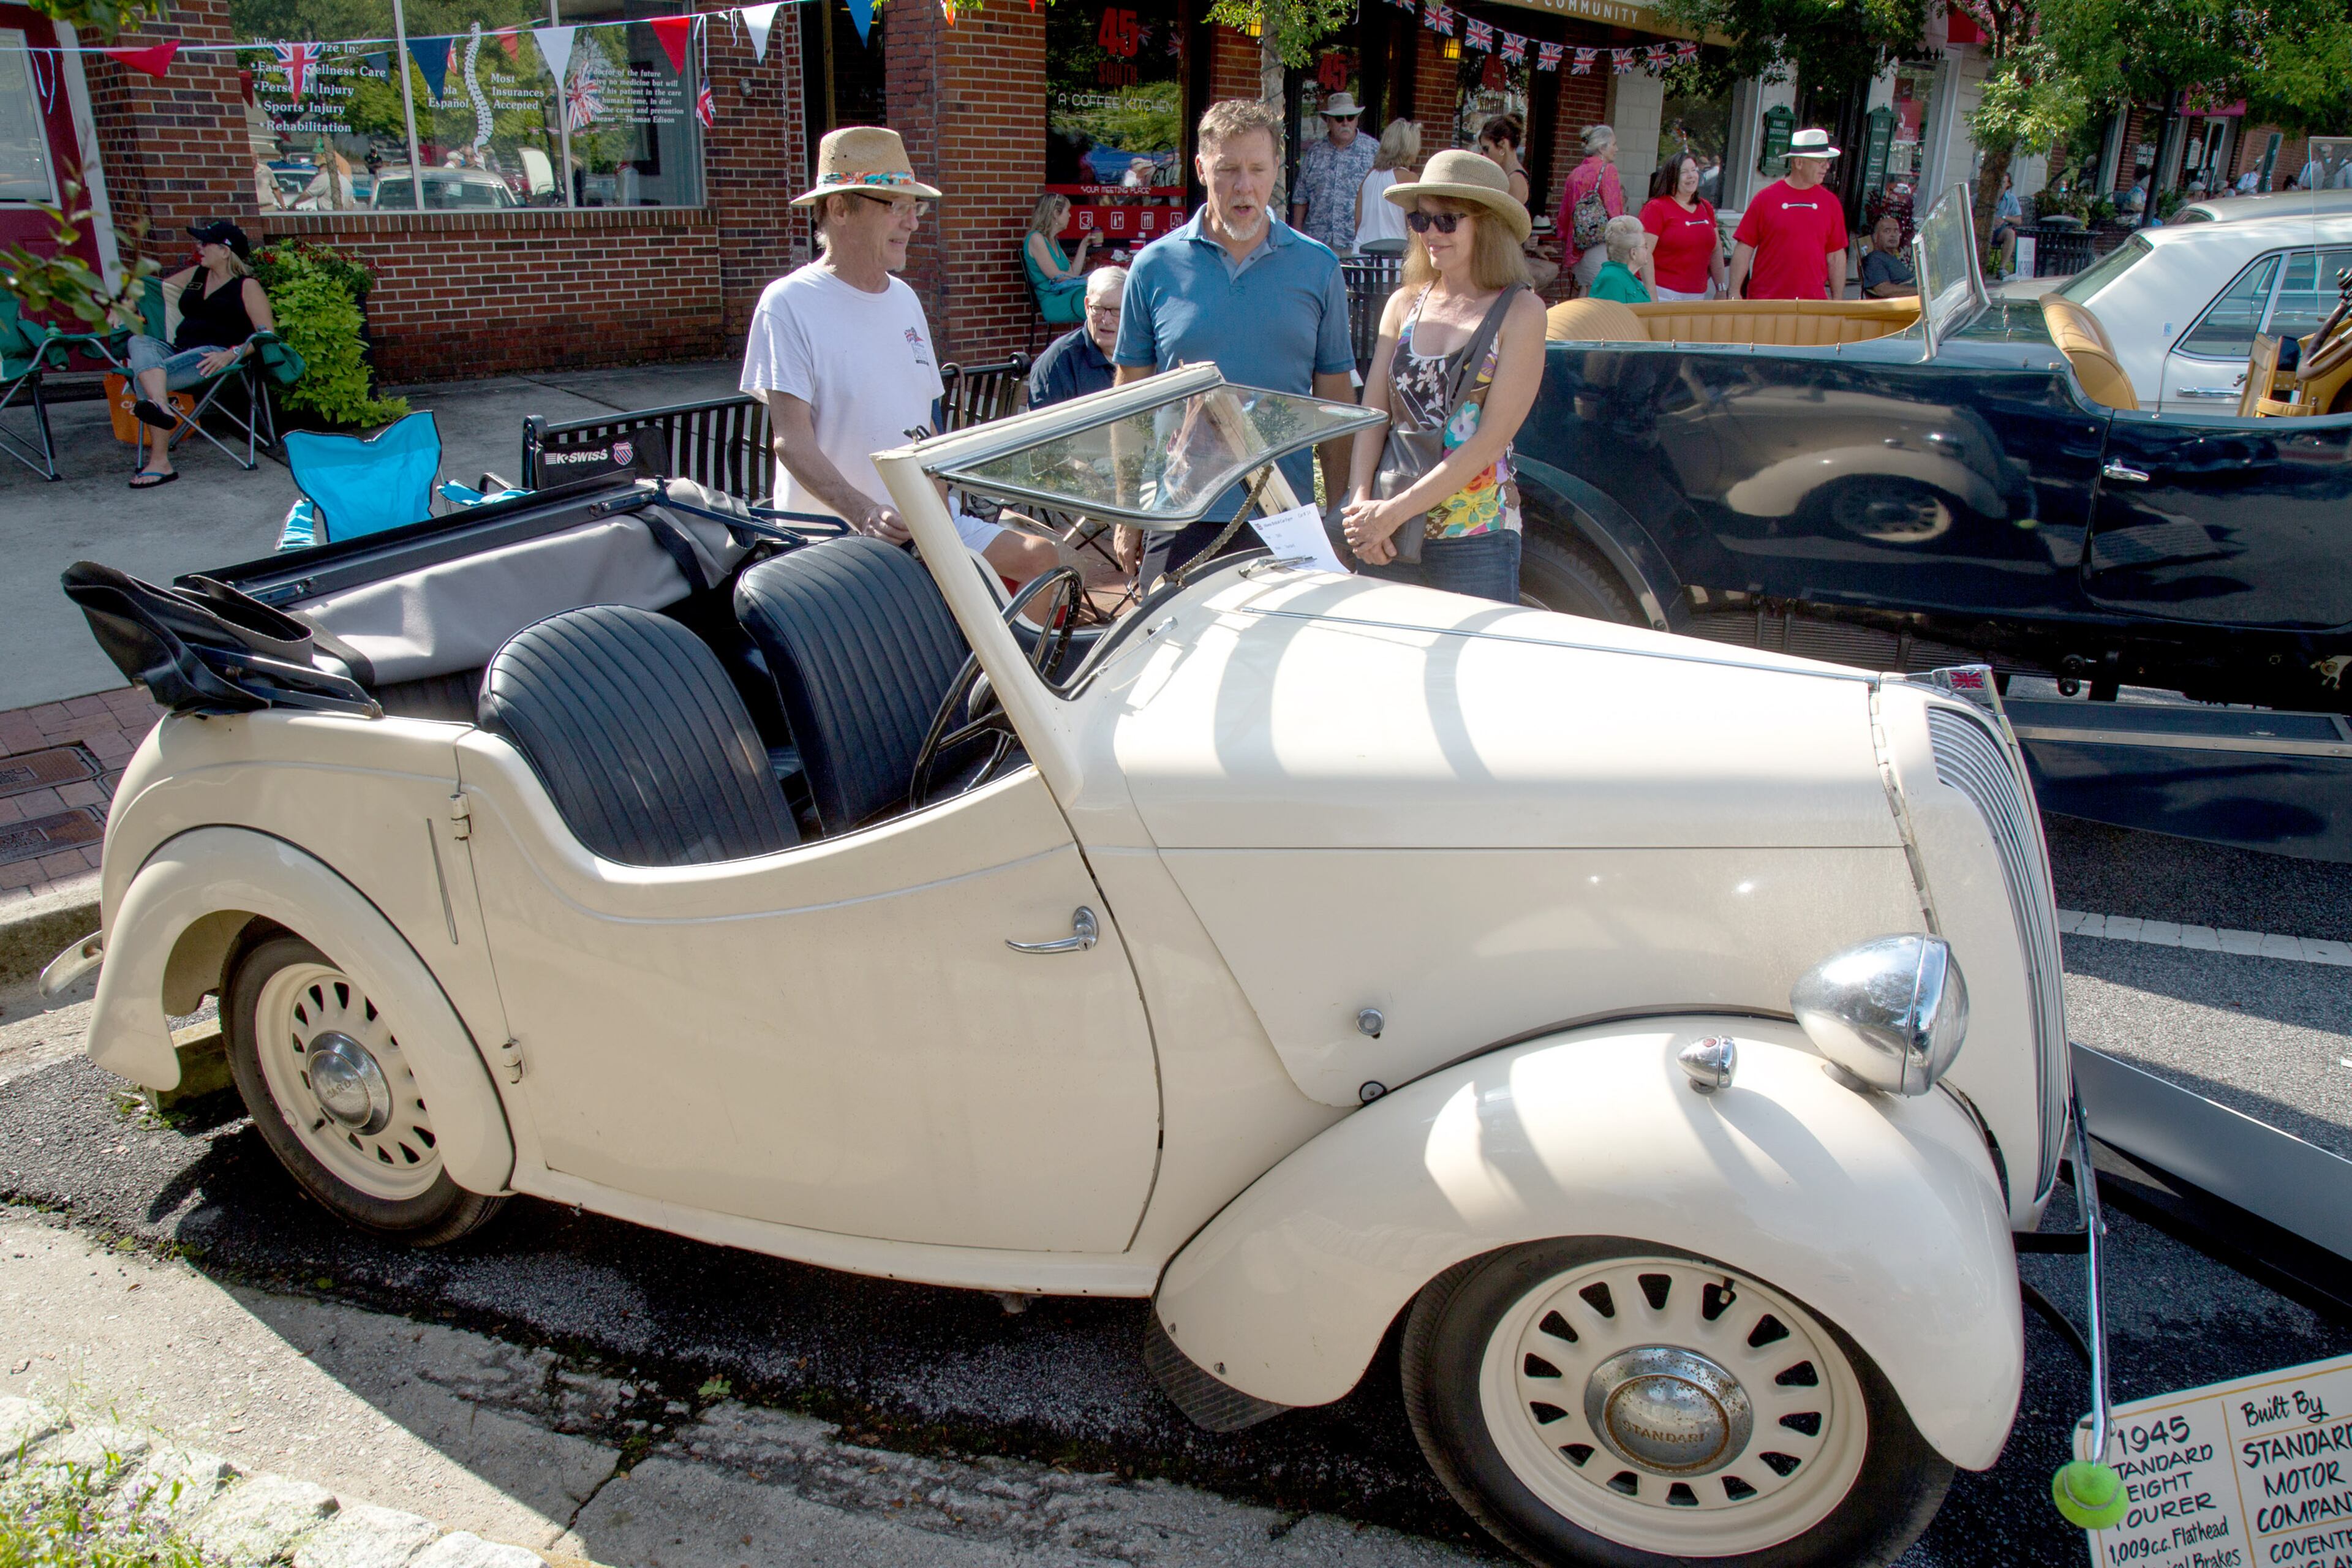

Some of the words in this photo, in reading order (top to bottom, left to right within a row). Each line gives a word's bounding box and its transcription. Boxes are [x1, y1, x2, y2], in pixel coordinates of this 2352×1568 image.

[1098, 7, 1137, 57] 45
[344, 43, 360, 53] In:
[360, 66, 386, 78] Care
[491, 73, 515, 83] Most
[641, 69, 662, 78] future
[1098, 62, 1137, 86] SOUTH
[1319, 53, 1347, 92] 45
[261, 81, 314, 93] Persoal
[318, 83, 354, 97] Injury
[492, 86, 545, 97] Insurances
[264, 100, 304, 114] Sports
[309, 102, 345, 115] Injury
[494, 100, 538, 111] Accepted
[1058, 93, 1066, 105] A
[1072, 94, 1120, 109] COFFEE
[1125, 99, 1174, 112] KITCHEN
[266, 120, 351, 132] Rehabilitation
[2240, 1395, 2290, 1428] Built
[2291, 1390, 2330, 1423] By
[2117, 1415, 2190, 1456] 1945
[2111, 1444, 2213, 1482] TANDARD
[2126, 1471, 2193, 1503] EIGHT
[2263, 1460, 2347, 1499] MOTOR
[2116, 1492, 2217, 1532] OURER
[2171, 1515, 2230, 1549] Flathead
